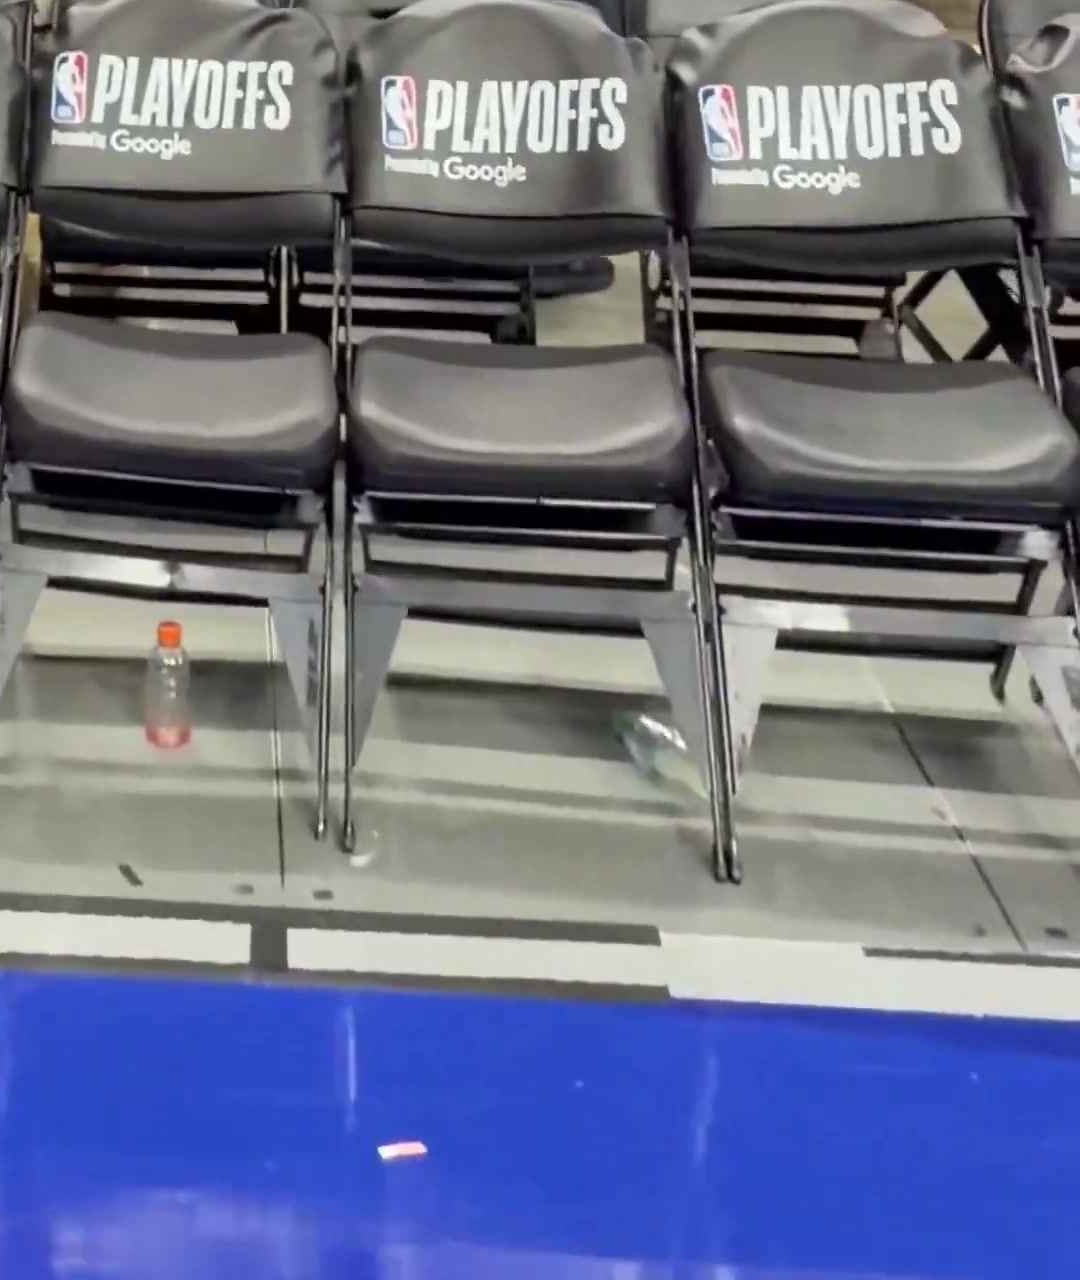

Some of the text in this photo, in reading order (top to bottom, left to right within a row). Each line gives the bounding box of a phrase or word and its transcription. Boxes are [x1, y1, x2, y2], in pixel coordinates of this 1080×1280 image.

[91, 54, 294, 131] PLAYOFFS
[423, 77, 628, 154] PLAYOFFS
[746, 78, 962, 161] PLAYOFFS
[110, 129, 192, 161] Google
[443, 155, 527, 188] Google
[773, 163, 862, 196] Google
